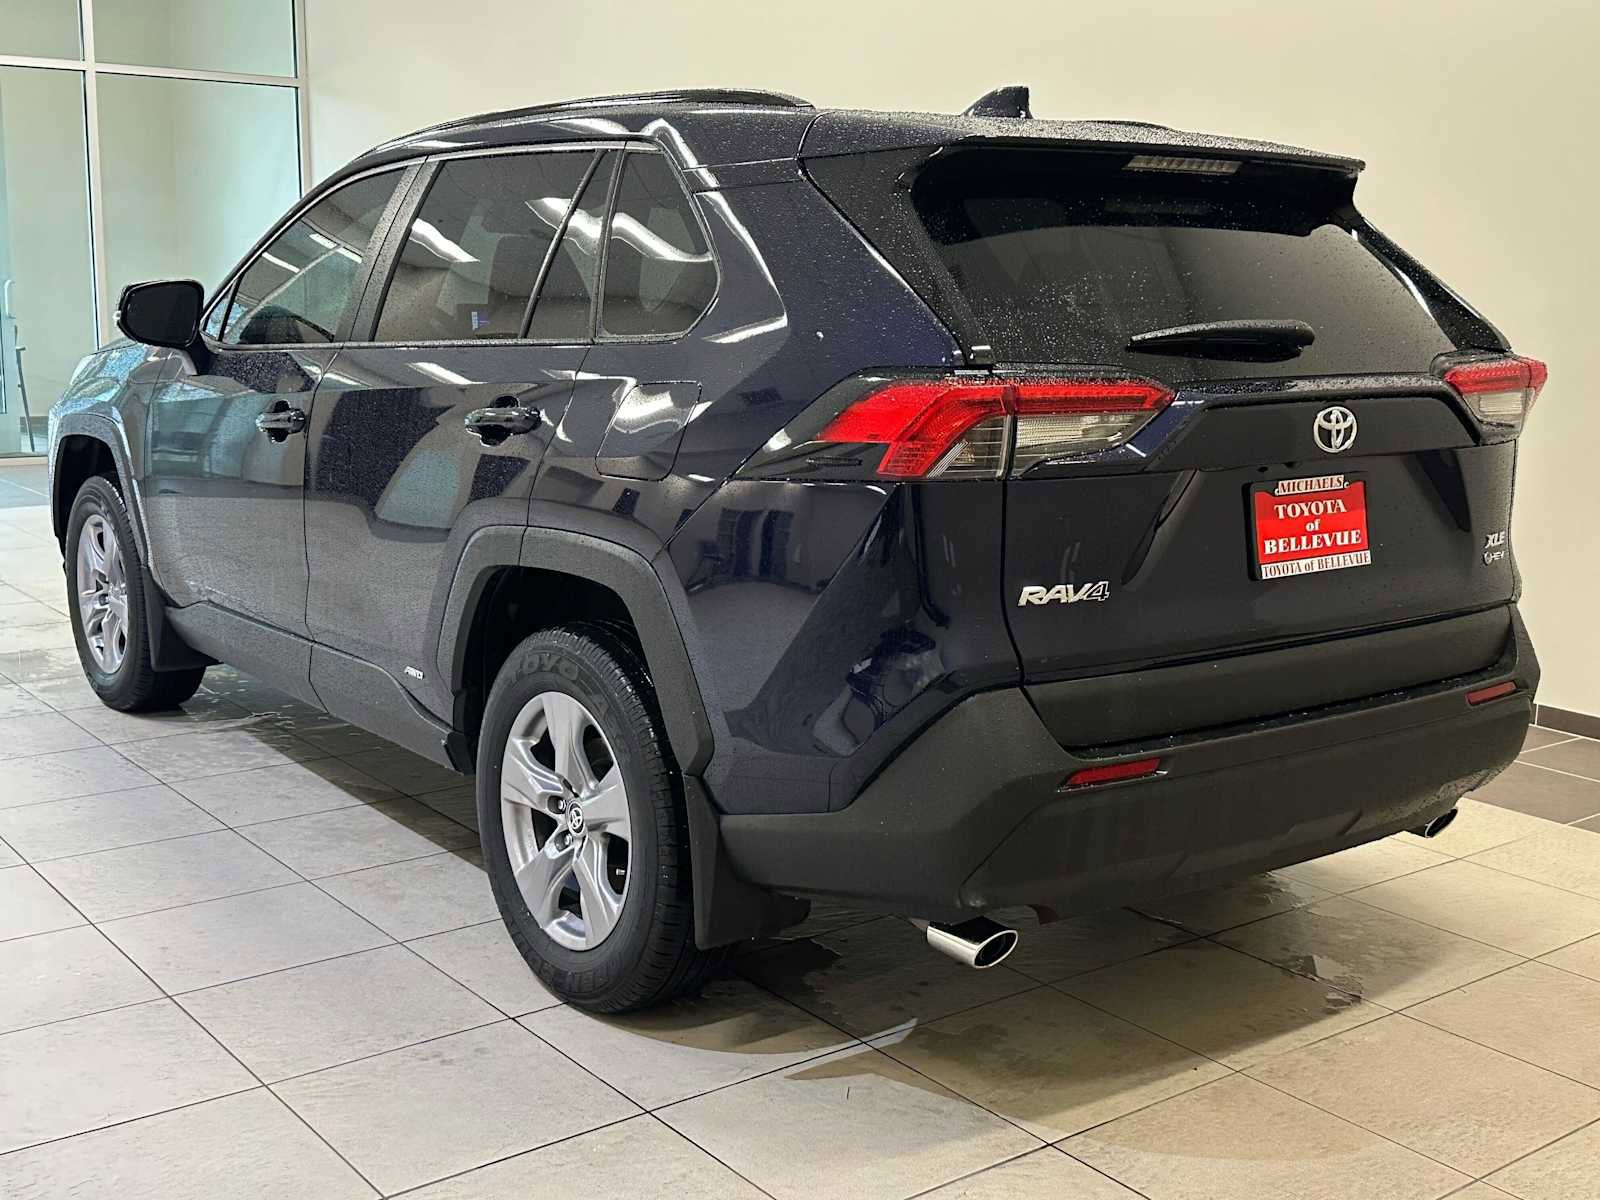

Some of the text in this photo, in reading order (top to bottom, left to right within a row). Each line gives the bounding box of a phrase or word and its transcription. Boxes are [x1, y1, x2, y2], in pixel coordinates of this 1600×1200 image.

[1279, 476, 1343, 493] MICHAELS
[1274, 499, 1347, 519] TOYOTA
[1305, 518, 1320, 532] of
[1264, 529, 1362, 555] BELLEVUE
[1485, 531, 1505, 548] XLE
[1263, 552, 1370, 578] TOYOTA of BELLEVUE
[1018, 581, 1110, 606] RAV4
